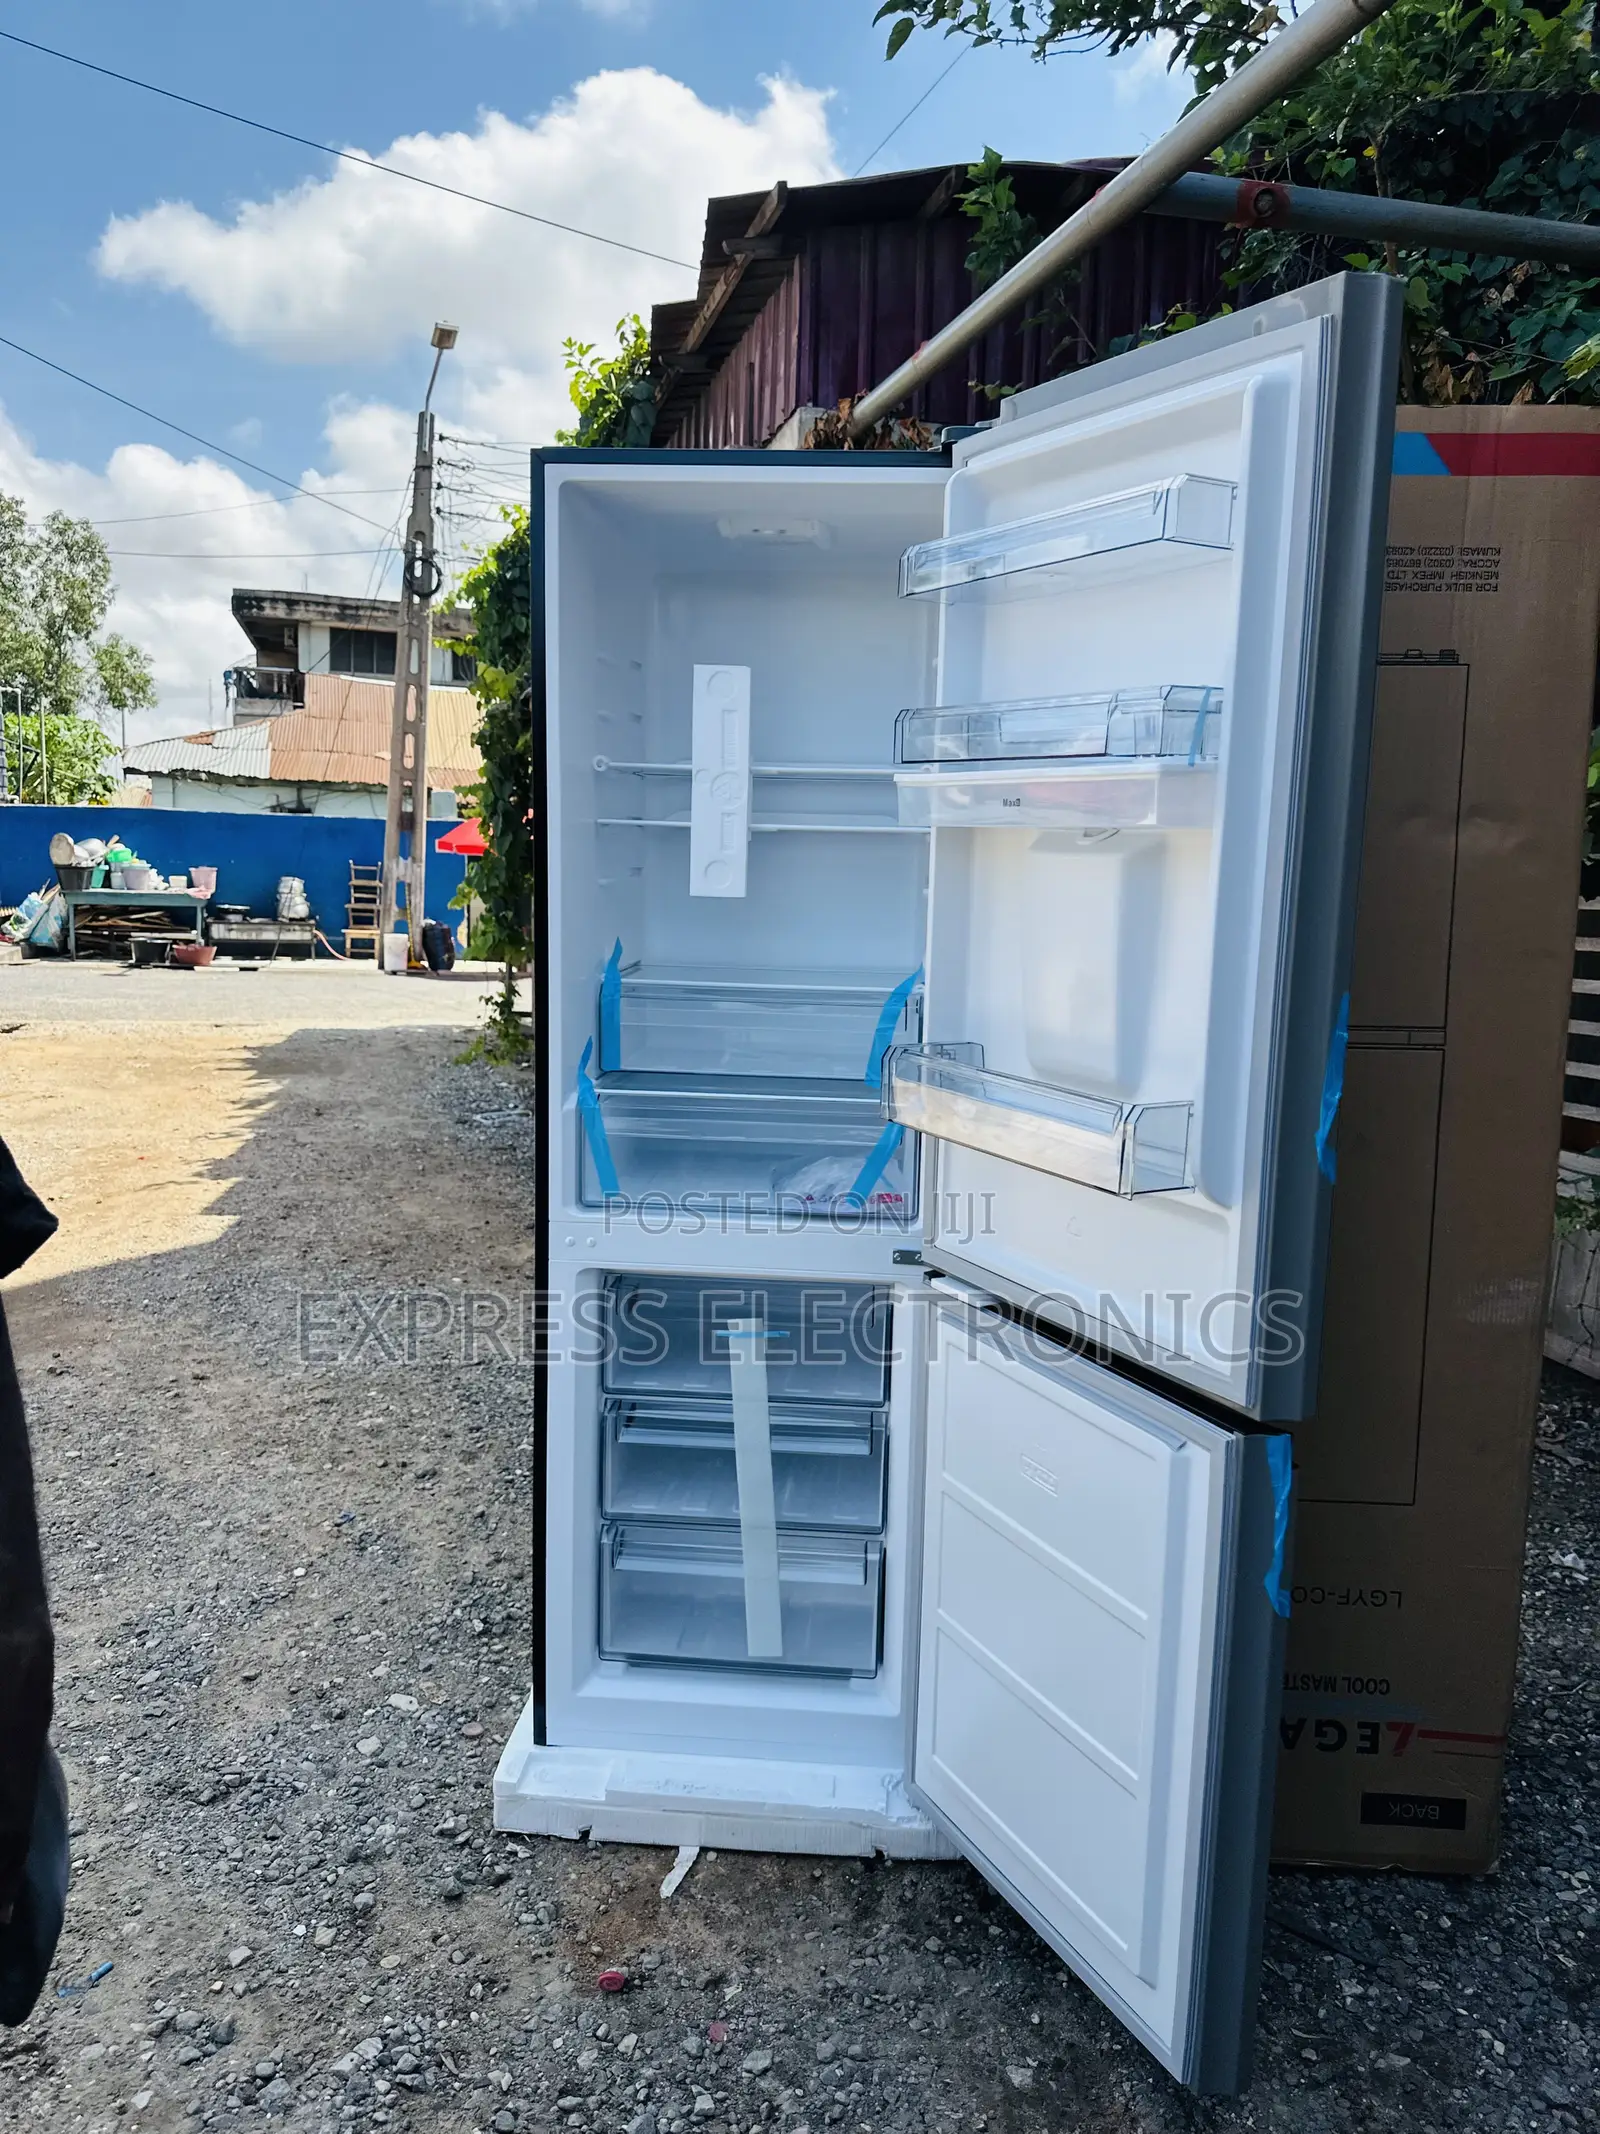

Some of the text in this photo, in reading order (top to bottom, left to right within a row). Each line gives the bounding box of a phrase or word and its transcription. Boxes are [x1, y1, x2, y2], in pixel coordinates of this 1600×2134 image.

[1424, 557, 1455, 568] (0302)
[1387, 570, 1499, 580] MENKISH IMPEX LTD
[1384, 582, 1498, 592] FOR BULK PURCHASE
[1342, 1676, 1391, 1696] COOL
[1388, 1801, 1440, 1820] BACK
